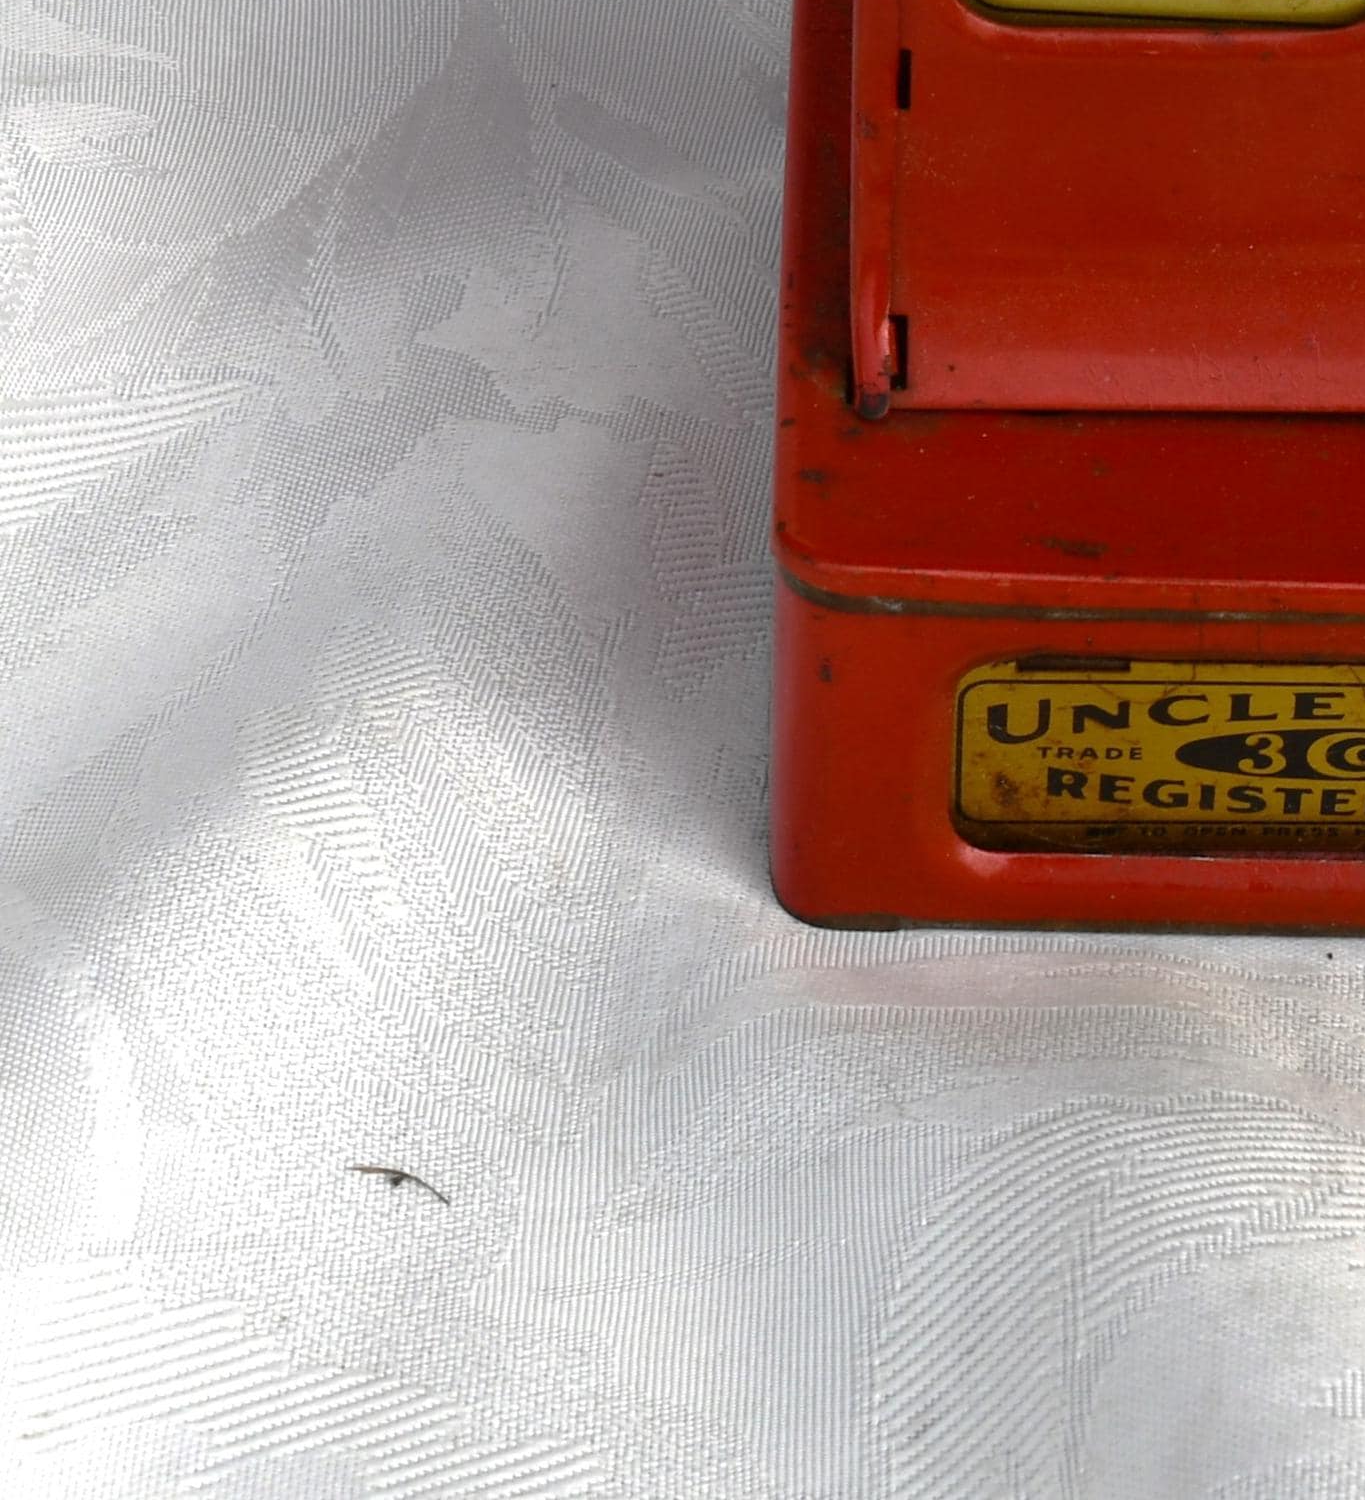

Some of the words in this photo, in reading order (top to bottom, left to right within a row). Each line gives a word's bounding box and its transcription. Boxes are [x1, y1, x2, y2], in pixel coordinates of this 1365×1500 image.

[986, 691, 1346, 746] UNCLE
[1037, 746, 1143, 761] TRADE
[1237, 732, 1288, 776] 3
